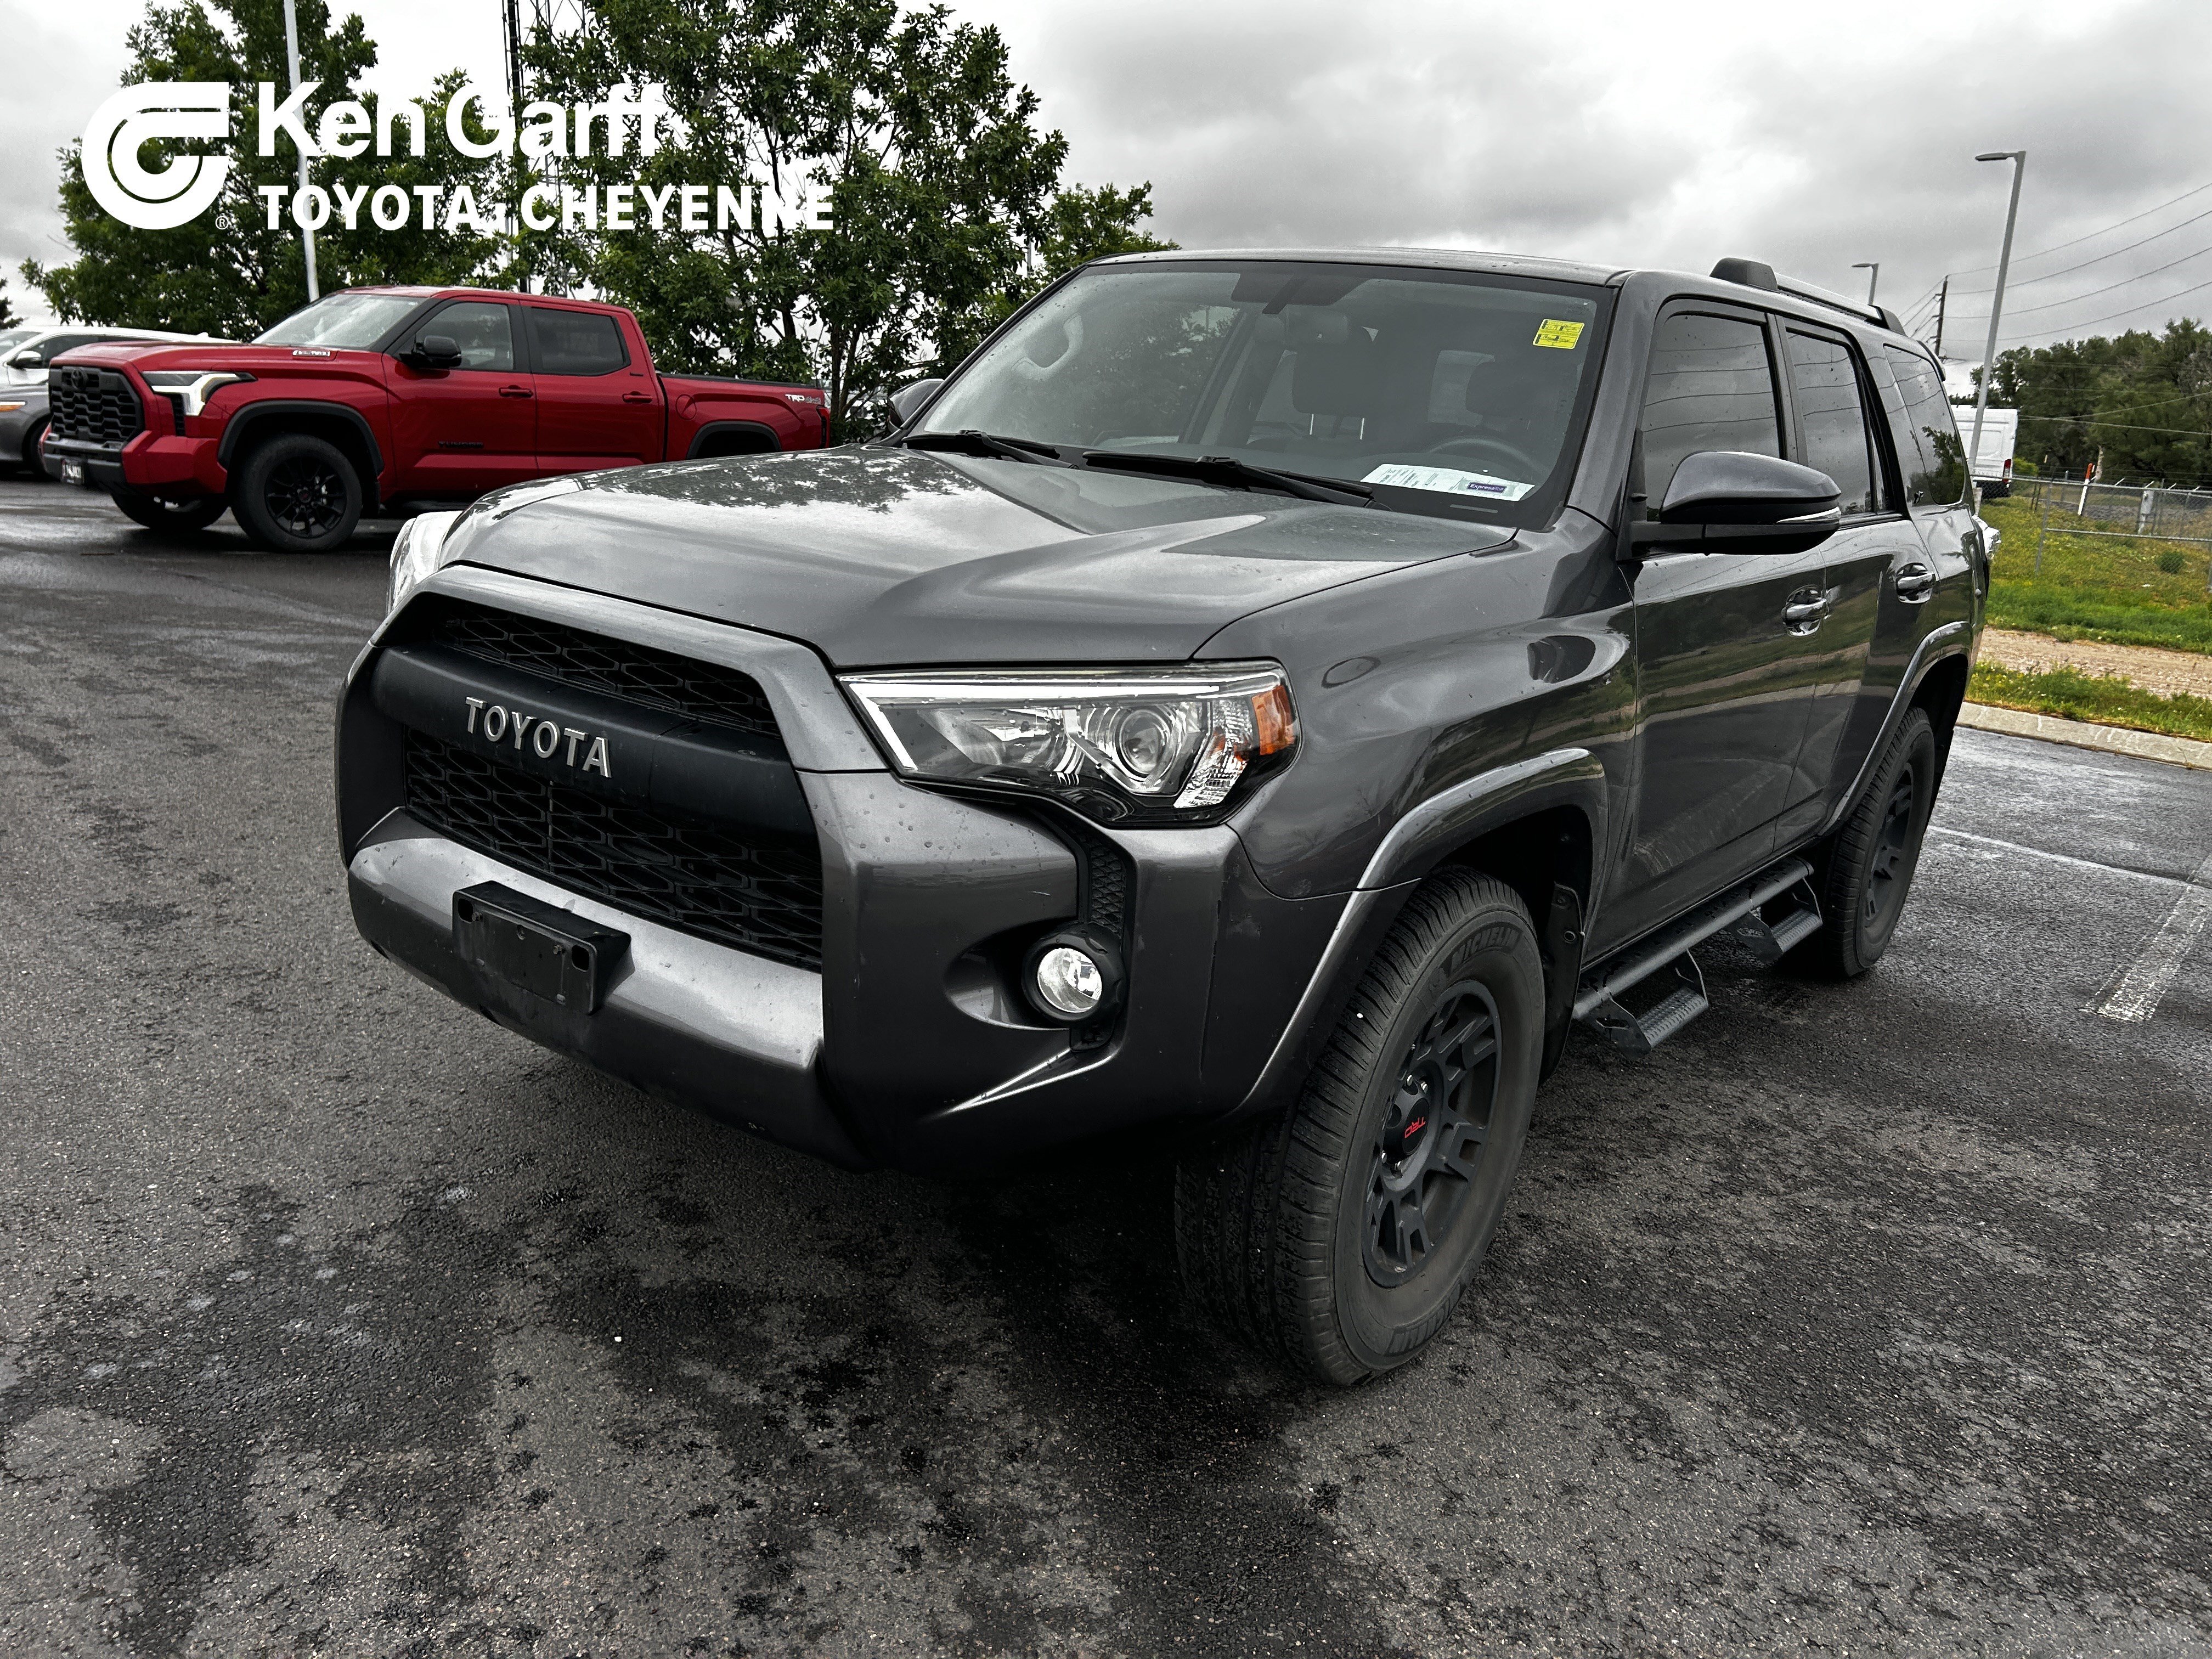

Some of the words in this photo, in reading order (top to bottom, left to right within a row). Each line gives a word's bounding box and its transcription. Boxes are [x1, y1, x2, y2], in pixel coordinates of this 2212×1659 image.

[465, 696, 612, 778] TOYOTA
[1451, 926, 1521, 975] MICHELIN
[1404, 1116, 1426, 1139] TRD
